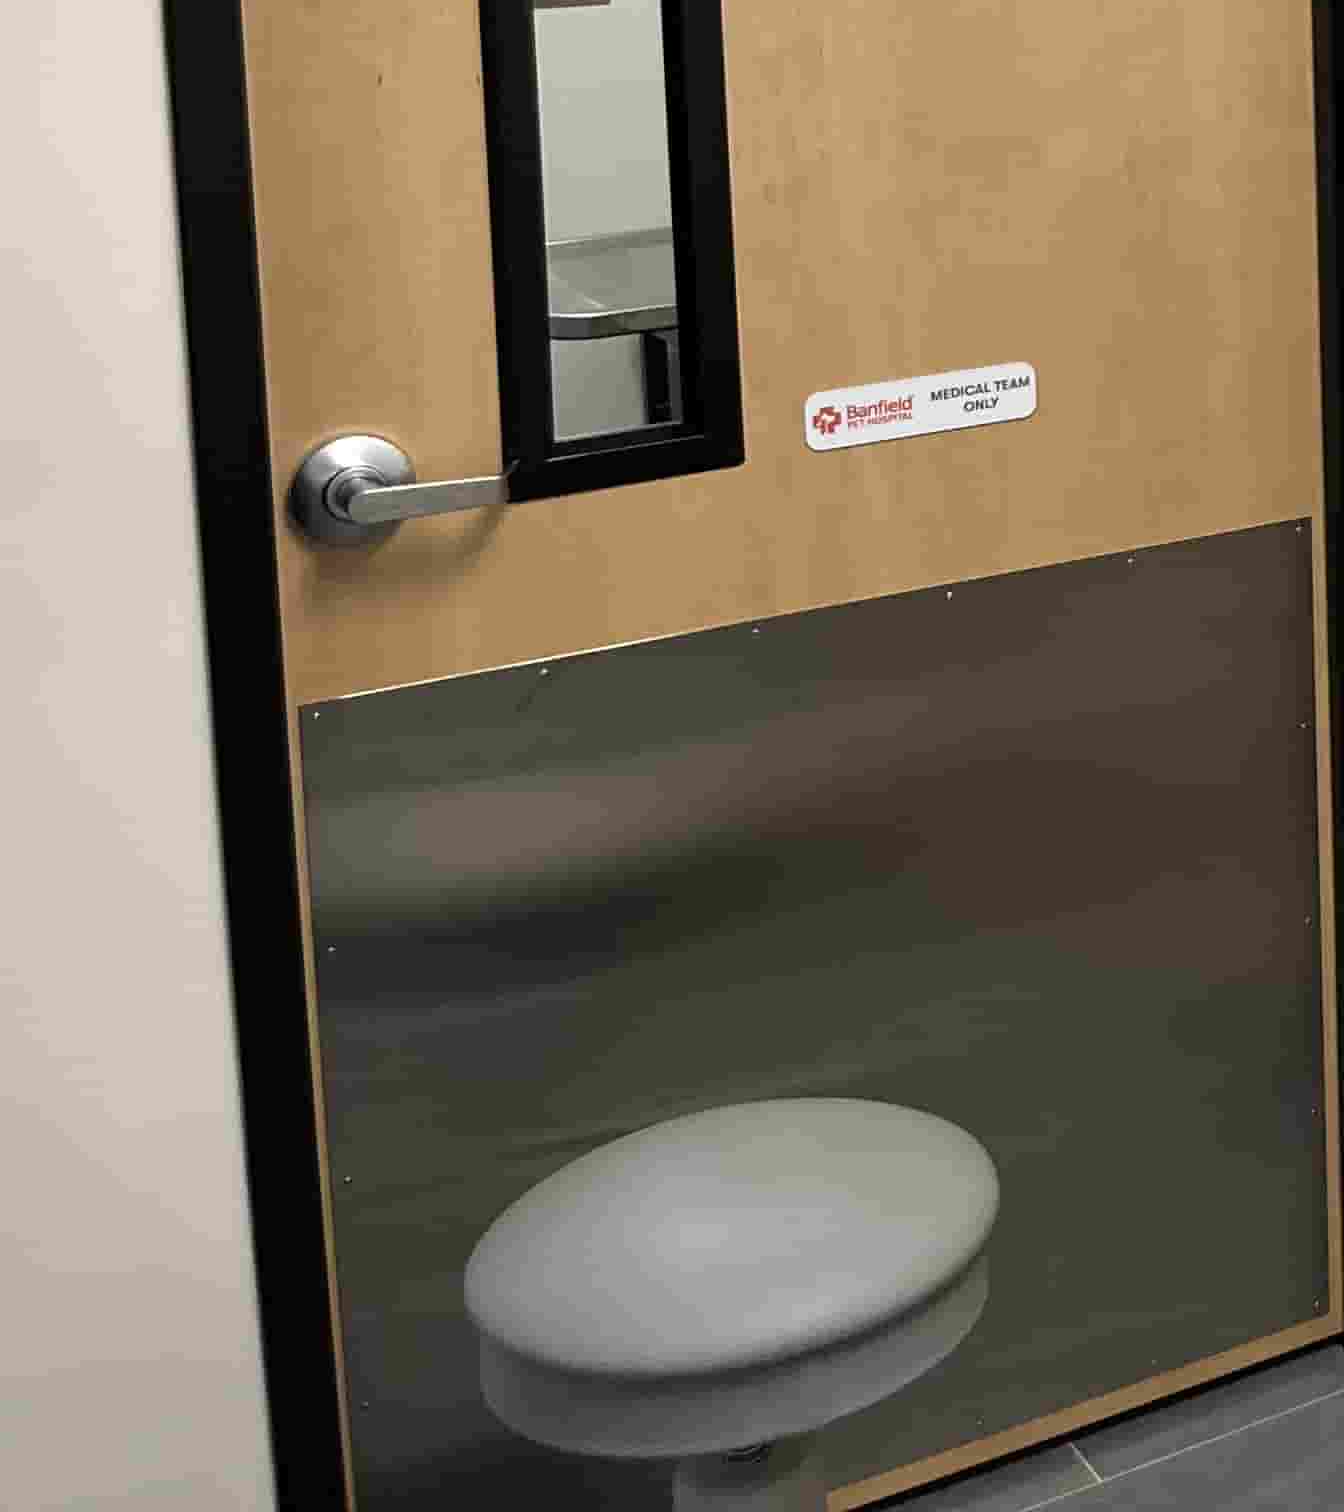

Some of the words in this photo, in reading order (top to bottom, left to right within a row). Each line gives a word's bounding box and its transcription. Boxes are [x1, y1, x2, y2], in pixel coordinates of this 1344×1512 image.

[931, 381, 991, 402] MEDICAL
[994, 376, 1030, 393] TEAM
[848, 396, 912, 419] Banfield
[964, 396, 999, 413] ONLY
